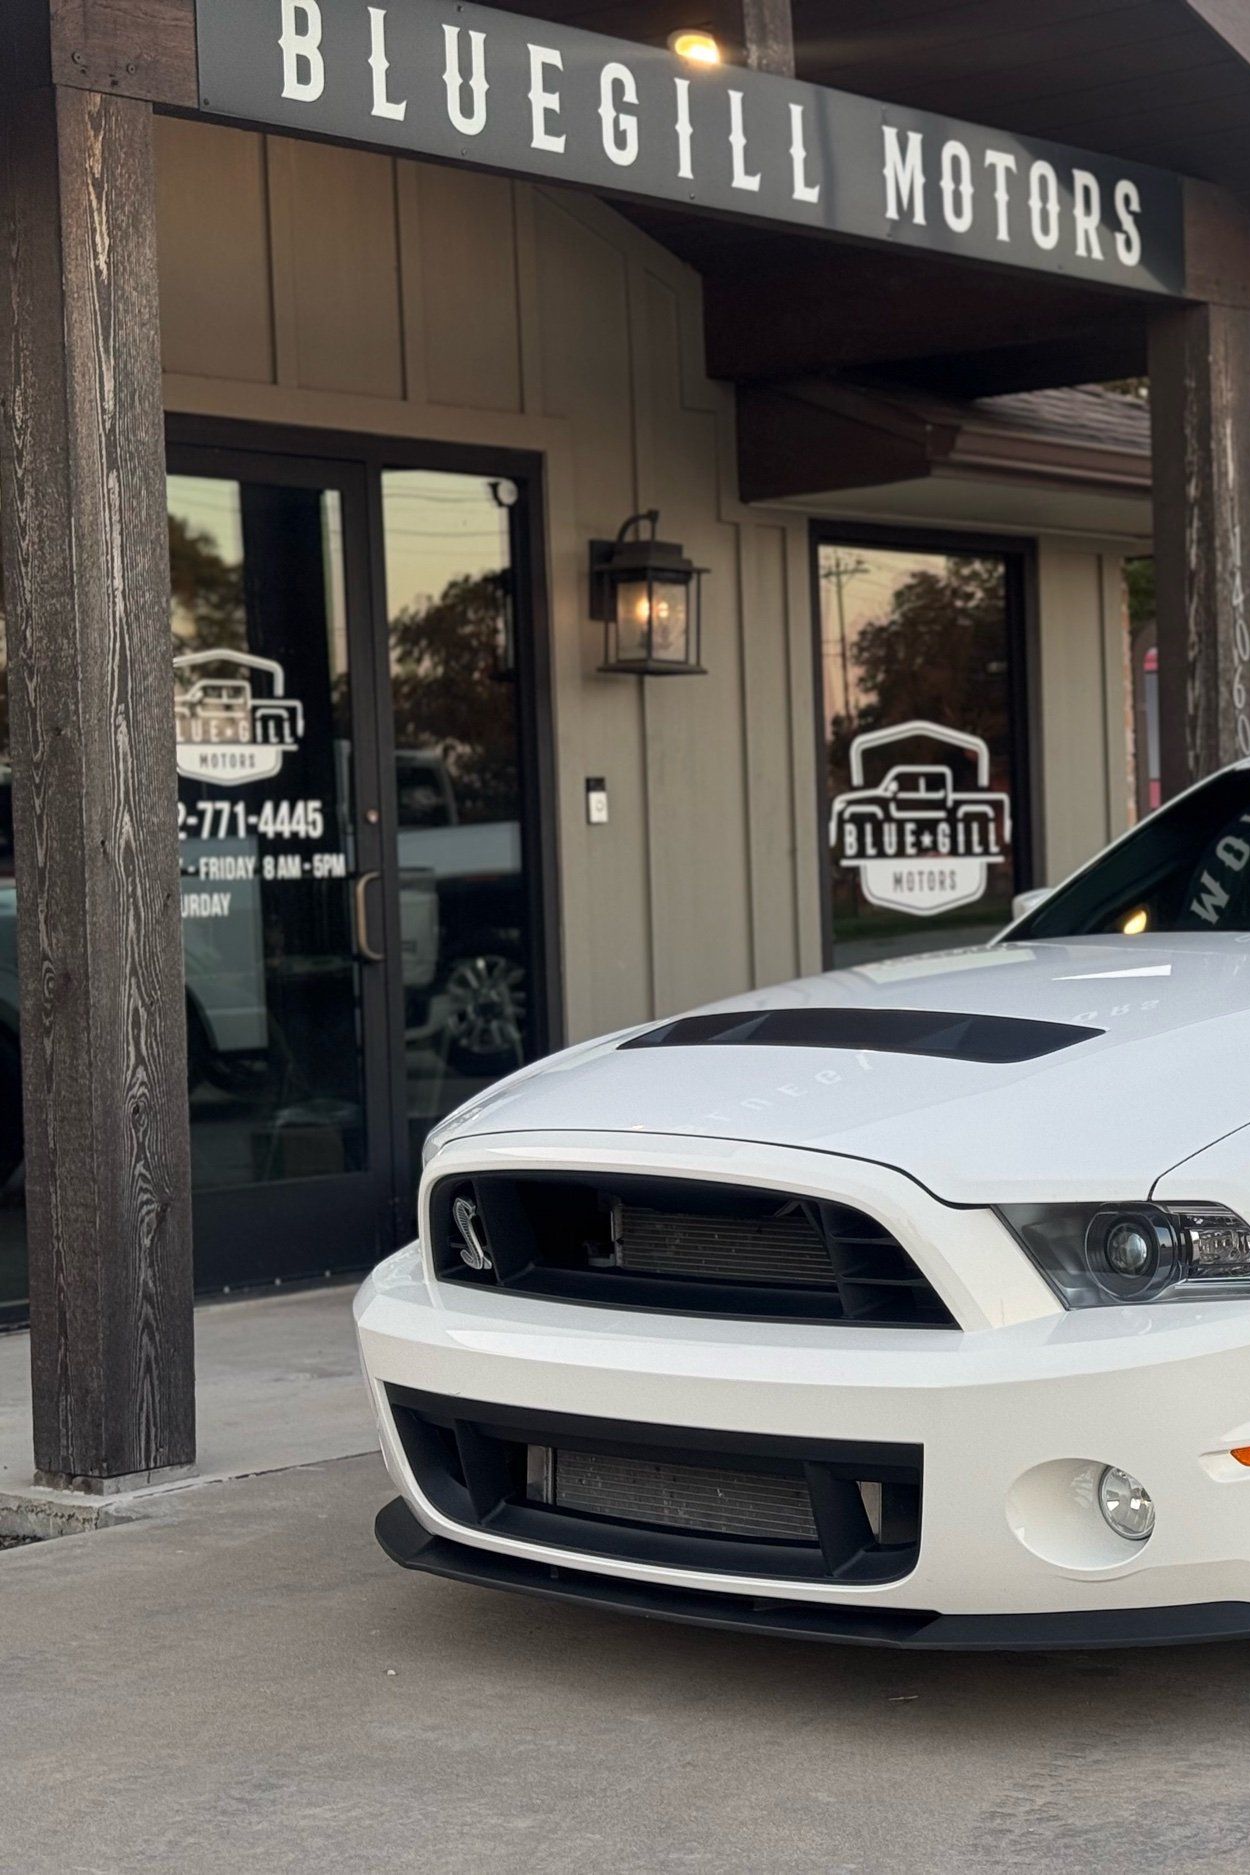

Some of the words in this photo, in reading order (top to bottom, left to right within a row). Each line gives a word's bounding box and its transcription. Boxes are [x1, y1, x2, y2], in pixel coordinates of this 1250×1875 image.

[278, 0, 820, 204] BLUEGILL
[881, 125, 1142, 267] MOTORS
[176, 718, 220, 742] LUE
[199, 753, 255, 769] MOTORS
[178, 800, 323, 840] 2-771-4445
[199, 855, 256, 881] FRIDAY
[893, 870, 957, 893] MOTORS
[180, 891, 231, 918] URDAY
